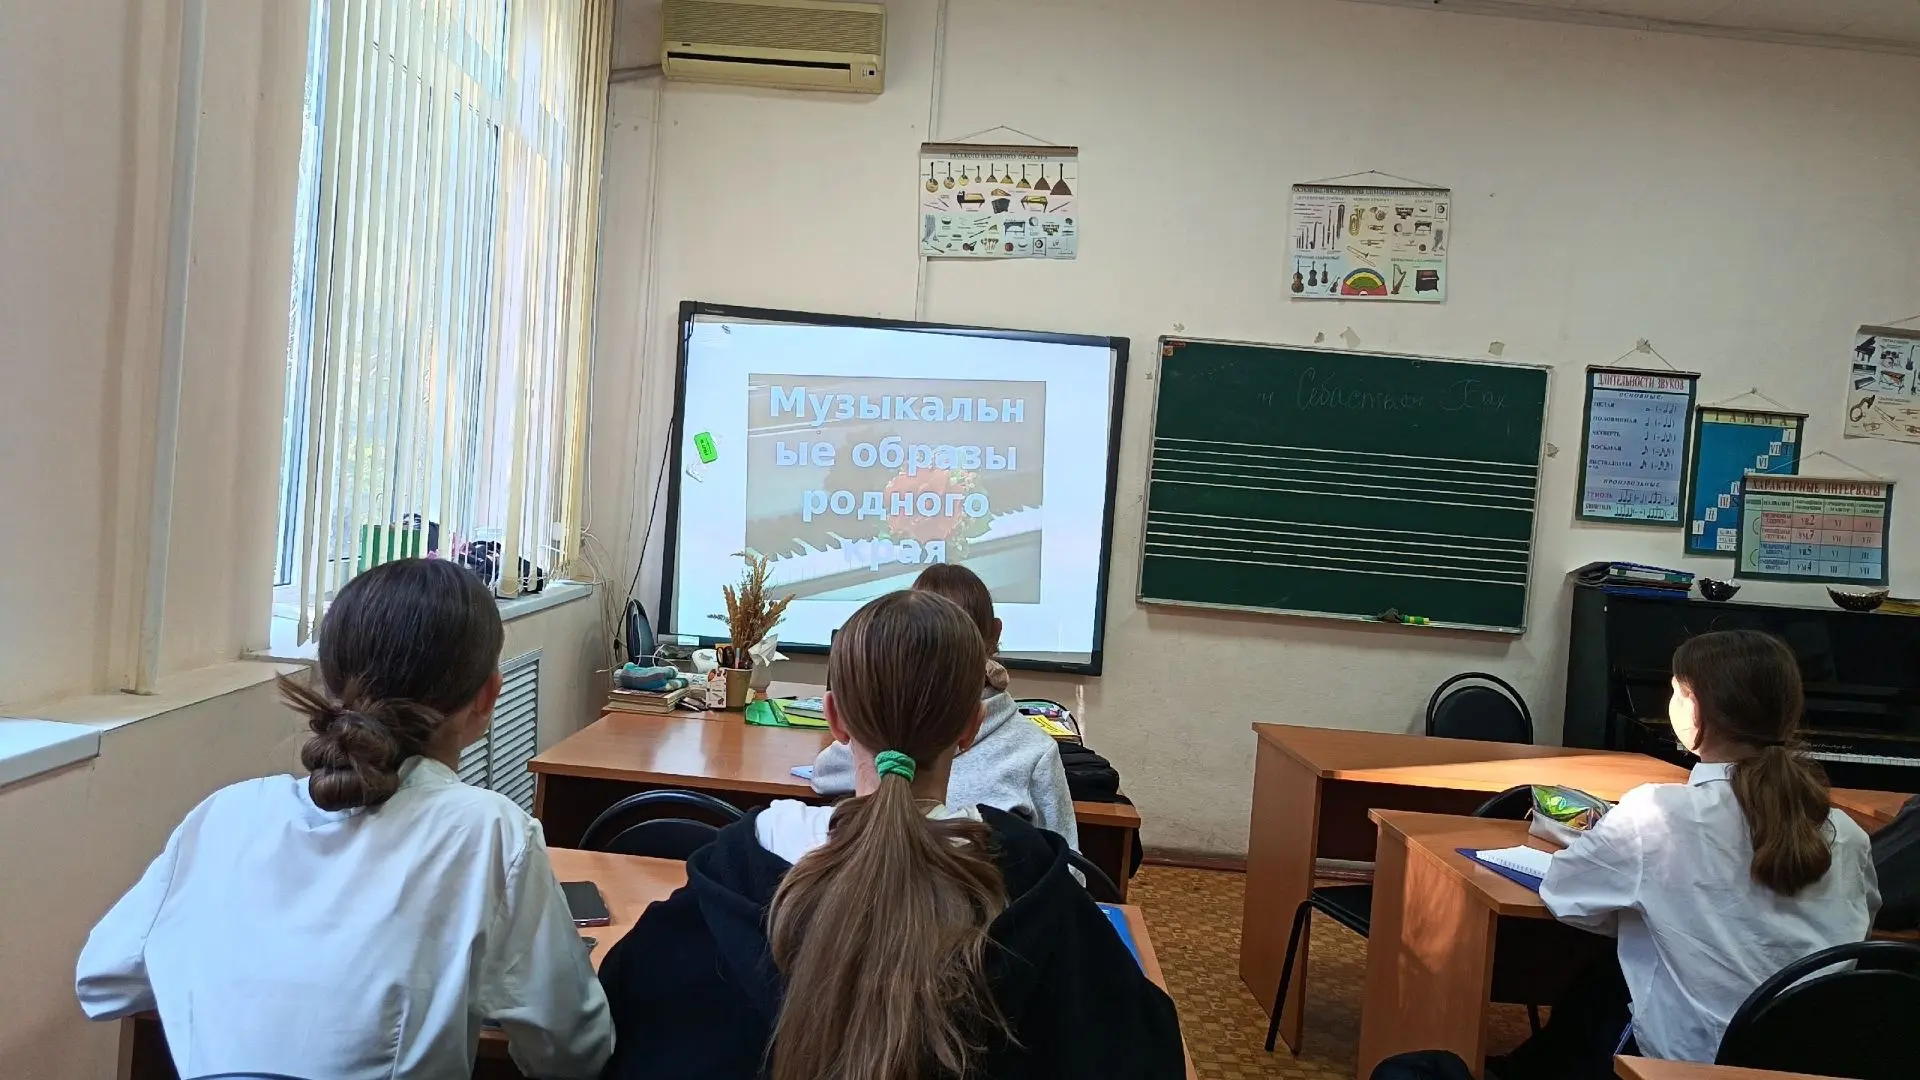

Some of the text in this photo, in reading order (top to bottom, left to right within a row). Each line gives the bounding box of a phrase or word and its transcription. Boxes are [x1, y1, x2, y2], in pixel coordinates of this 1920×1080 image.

[1657, 378, 1684, 390] ЗВУКОВ
[770, 385, 1025, 427] Музыкальн
[775, 436, 1017, 477] ые образы
[802, 489, 990, 523] родного
[844, 538, 946, 572] края
